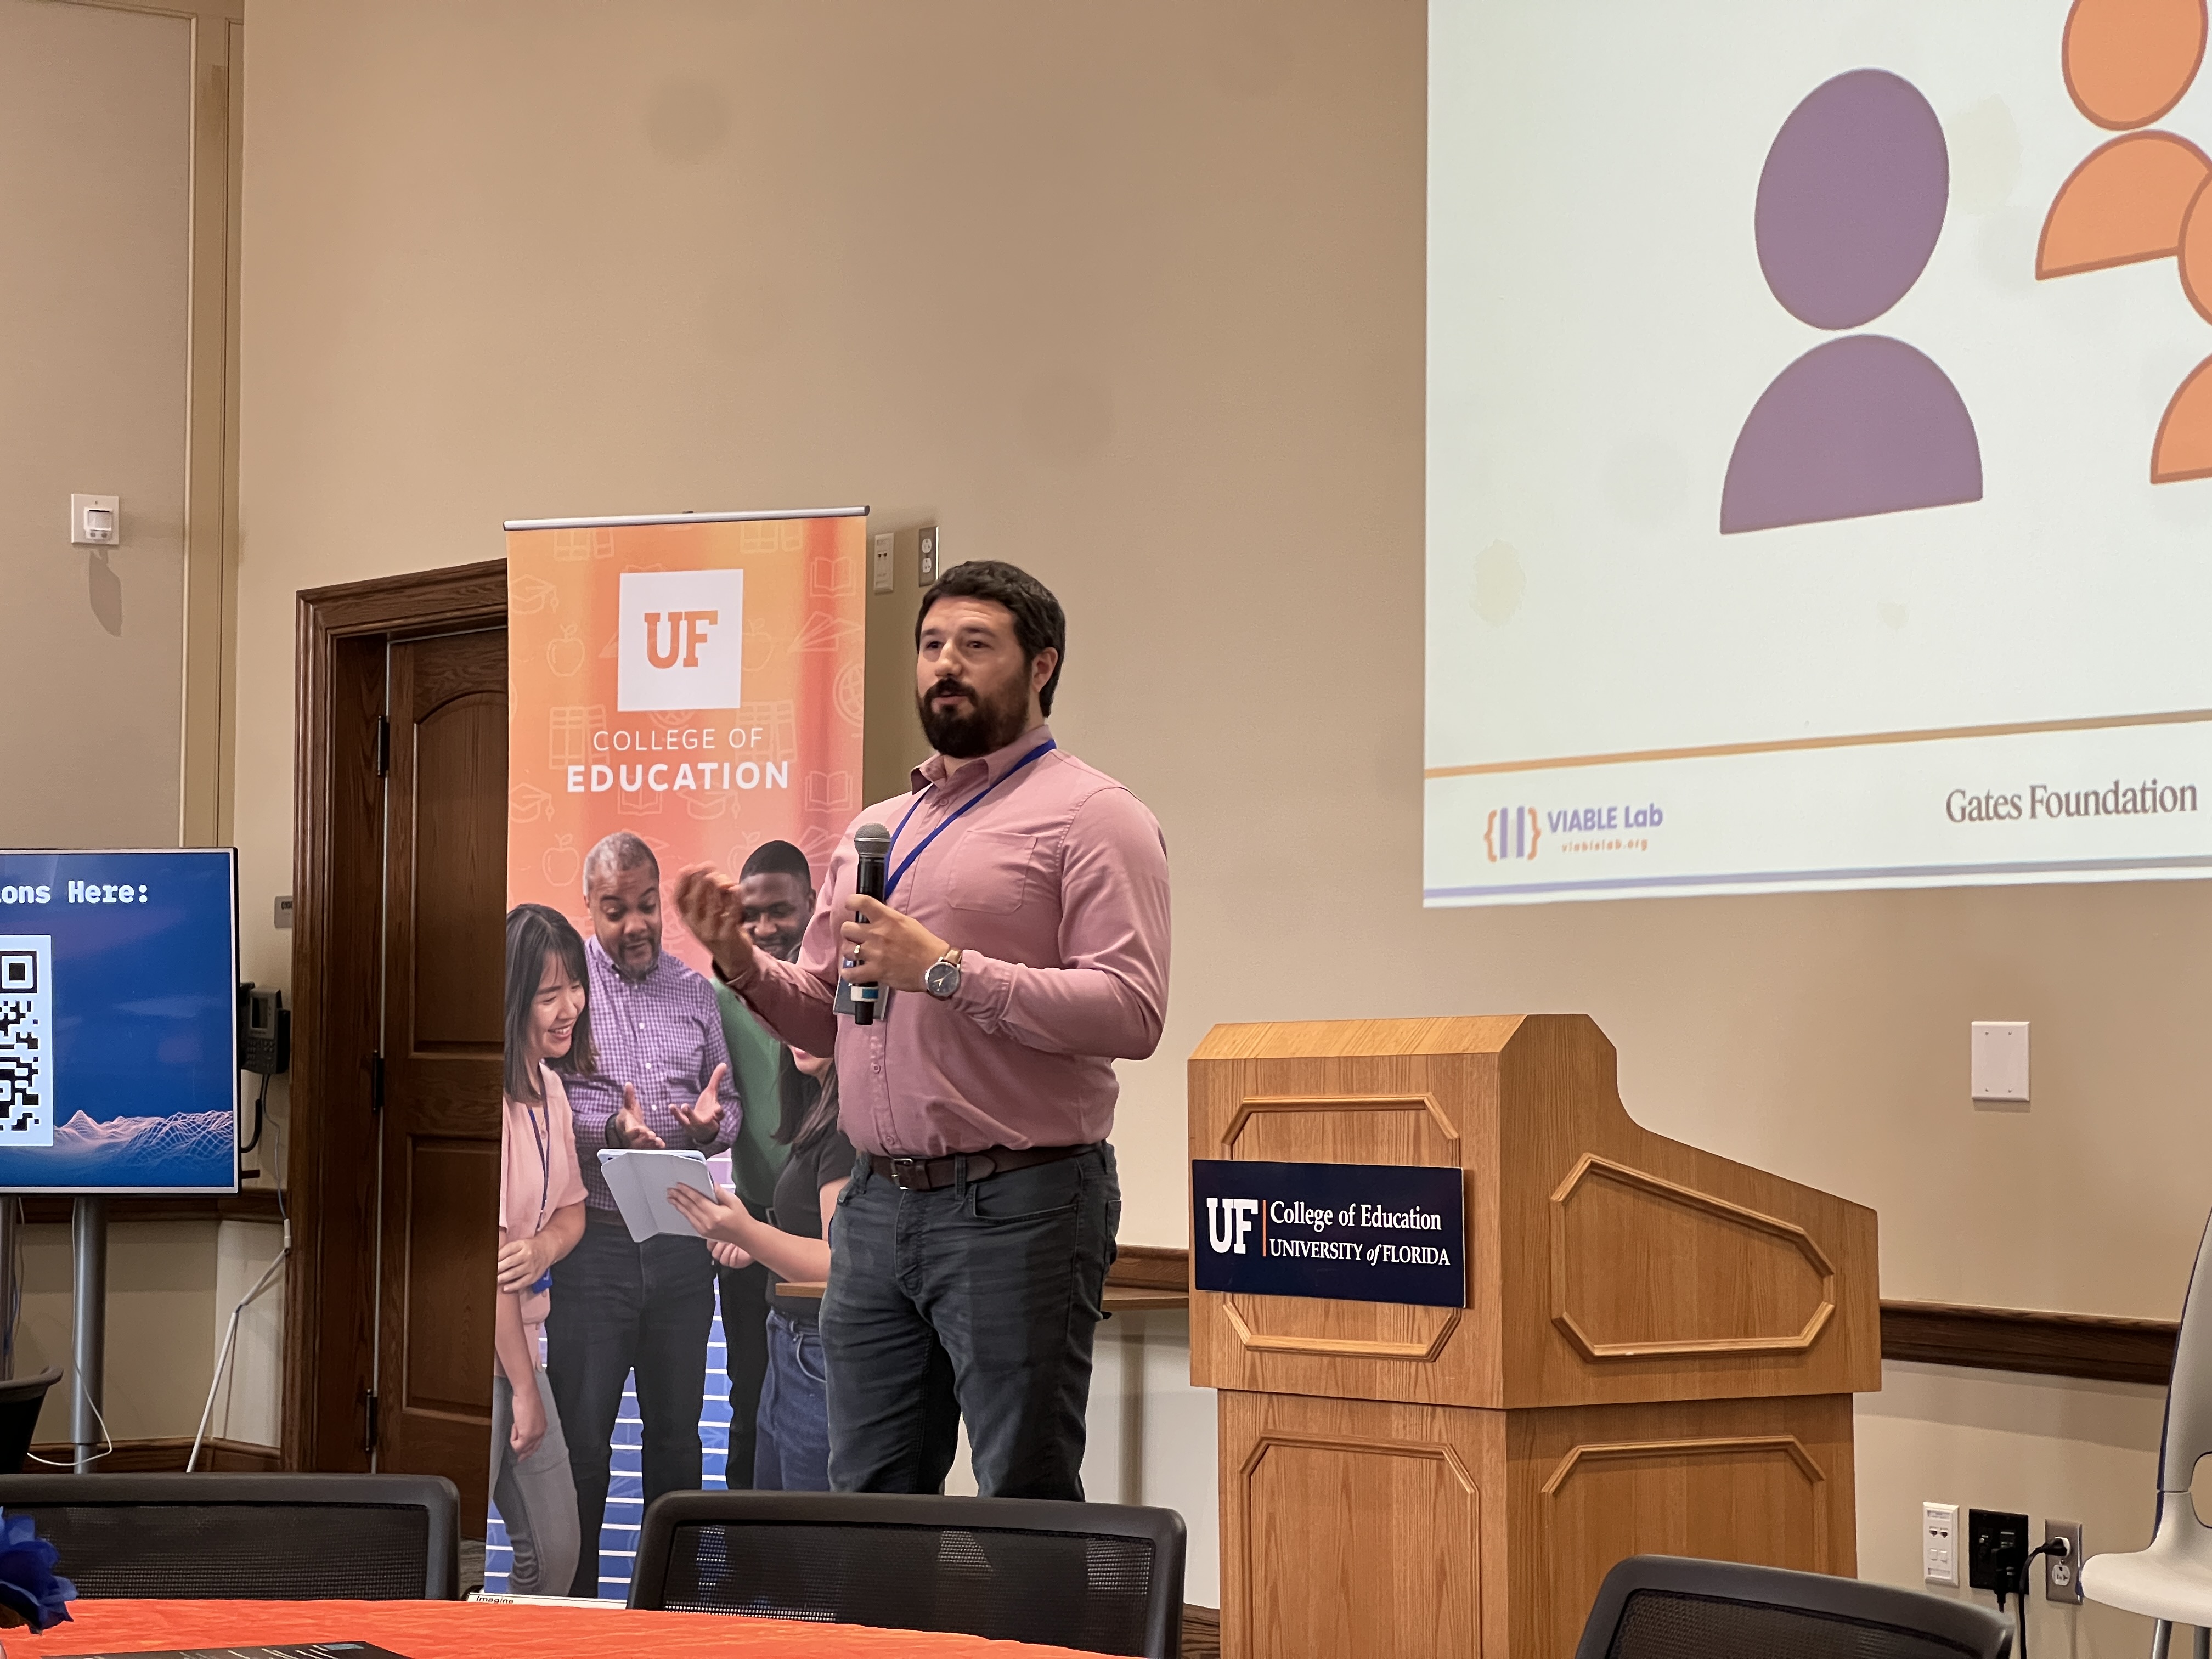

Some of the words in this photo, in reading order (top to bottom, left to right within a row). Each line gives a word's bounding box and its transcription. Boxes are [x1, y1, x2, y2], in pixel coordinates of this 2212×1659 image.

[644, 610, 718, 669] UF
[593, 728, 715, 751] COLLEGE
[729, 727, 763, 748] OF
[566, 761, 788, 792] EDUCATION
[1945, 789, 2022, 823] Gates
[2029, 778, 2198, 819] Foundation
[1547, 806, 1618, 833] VIABLE
[1624, 802, 1663, 828] Lab
[1561, 838, 1648, 853] viablelab.org
[0, 885, 51, 904] ons
[68, 880, 148, 904] Here:
[1206, 1197, 1258, 1254] UF
[1270, 1200, 1333, 1232] College
[1339, 1203, 1356, 1226] of
[1361, 1204, 1442, 1230] Education
[1269, 1239, 1363, 1260] UNIVERSITY
[1366, 1244, 1381, 1266] of
[1383, 1245, 1451, 1265] FLORIDA
